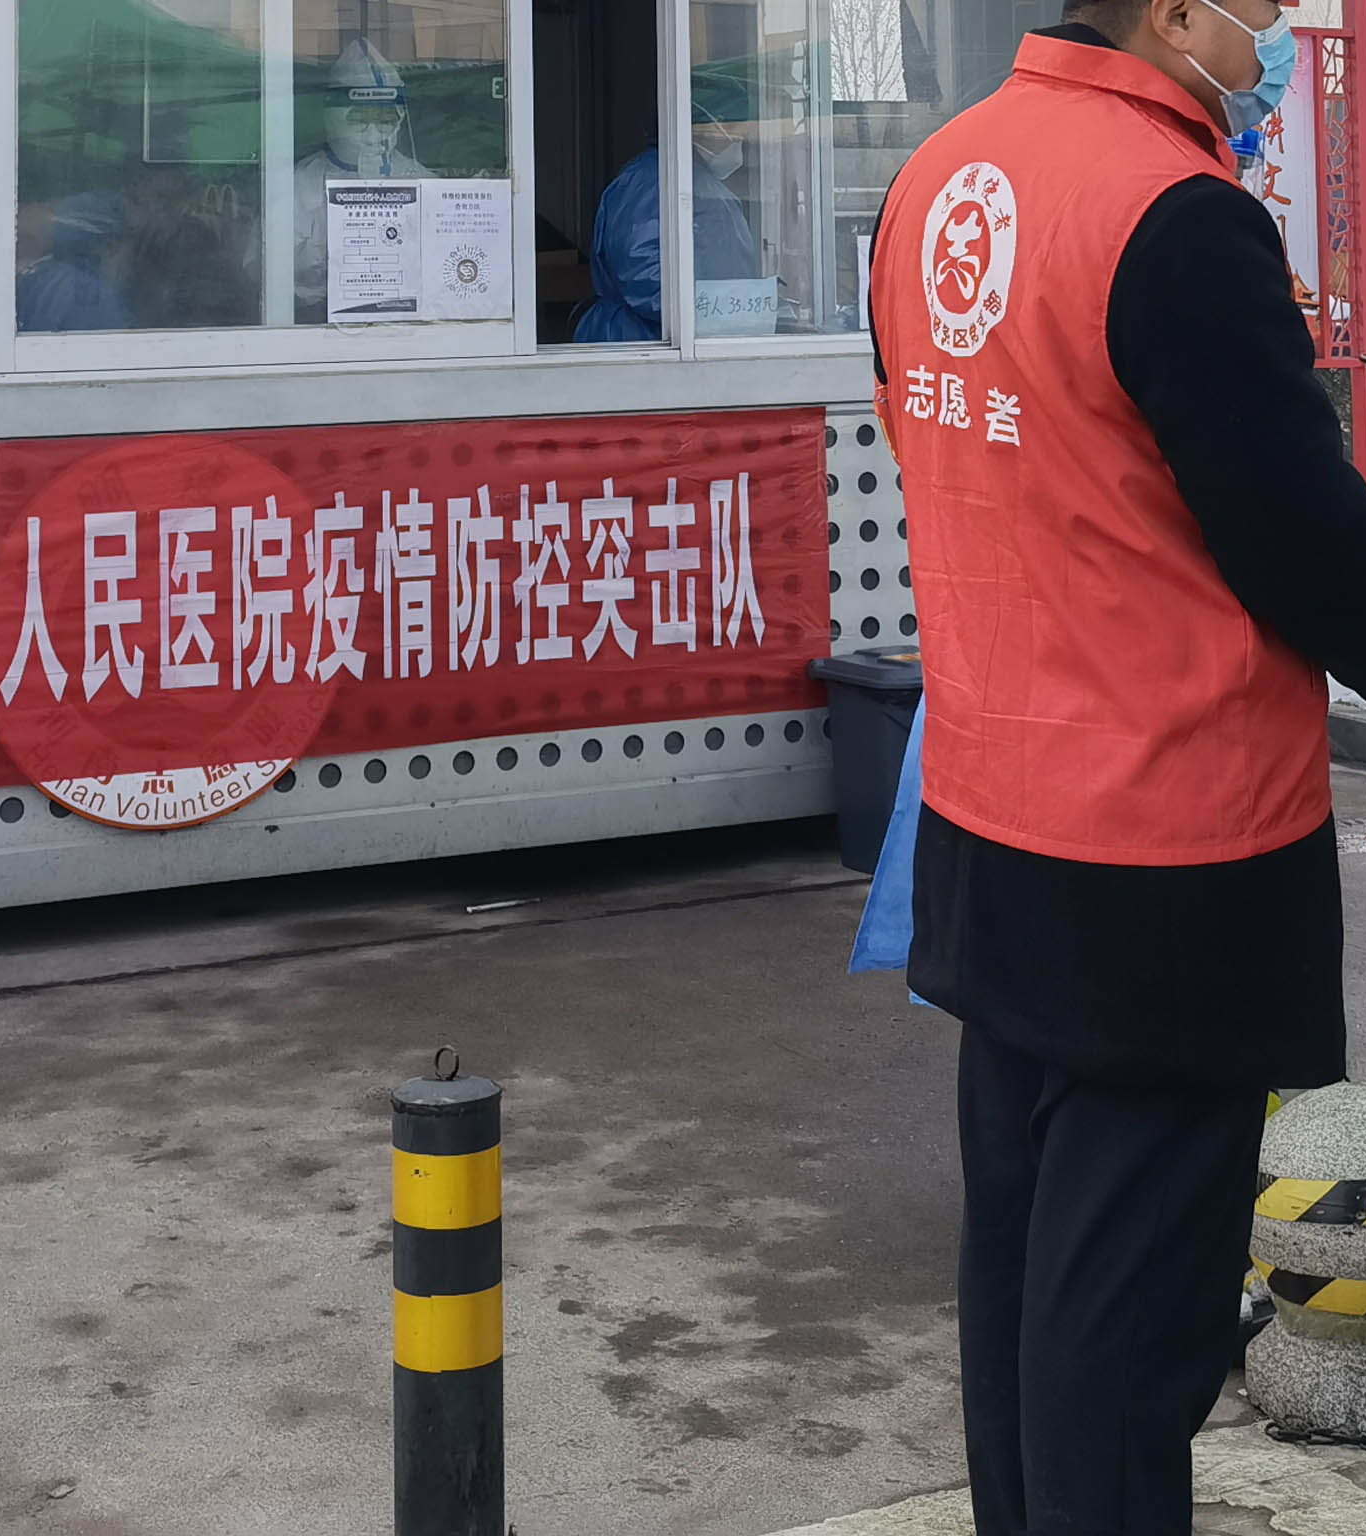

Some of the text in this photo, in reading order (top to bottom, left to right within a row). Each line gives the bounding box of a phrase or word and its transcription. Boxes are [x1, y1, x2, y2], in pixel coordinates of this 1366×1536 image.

[904, 364, 1021, 447] 志愿者
[116, 768, 253, 821] Volunteer
